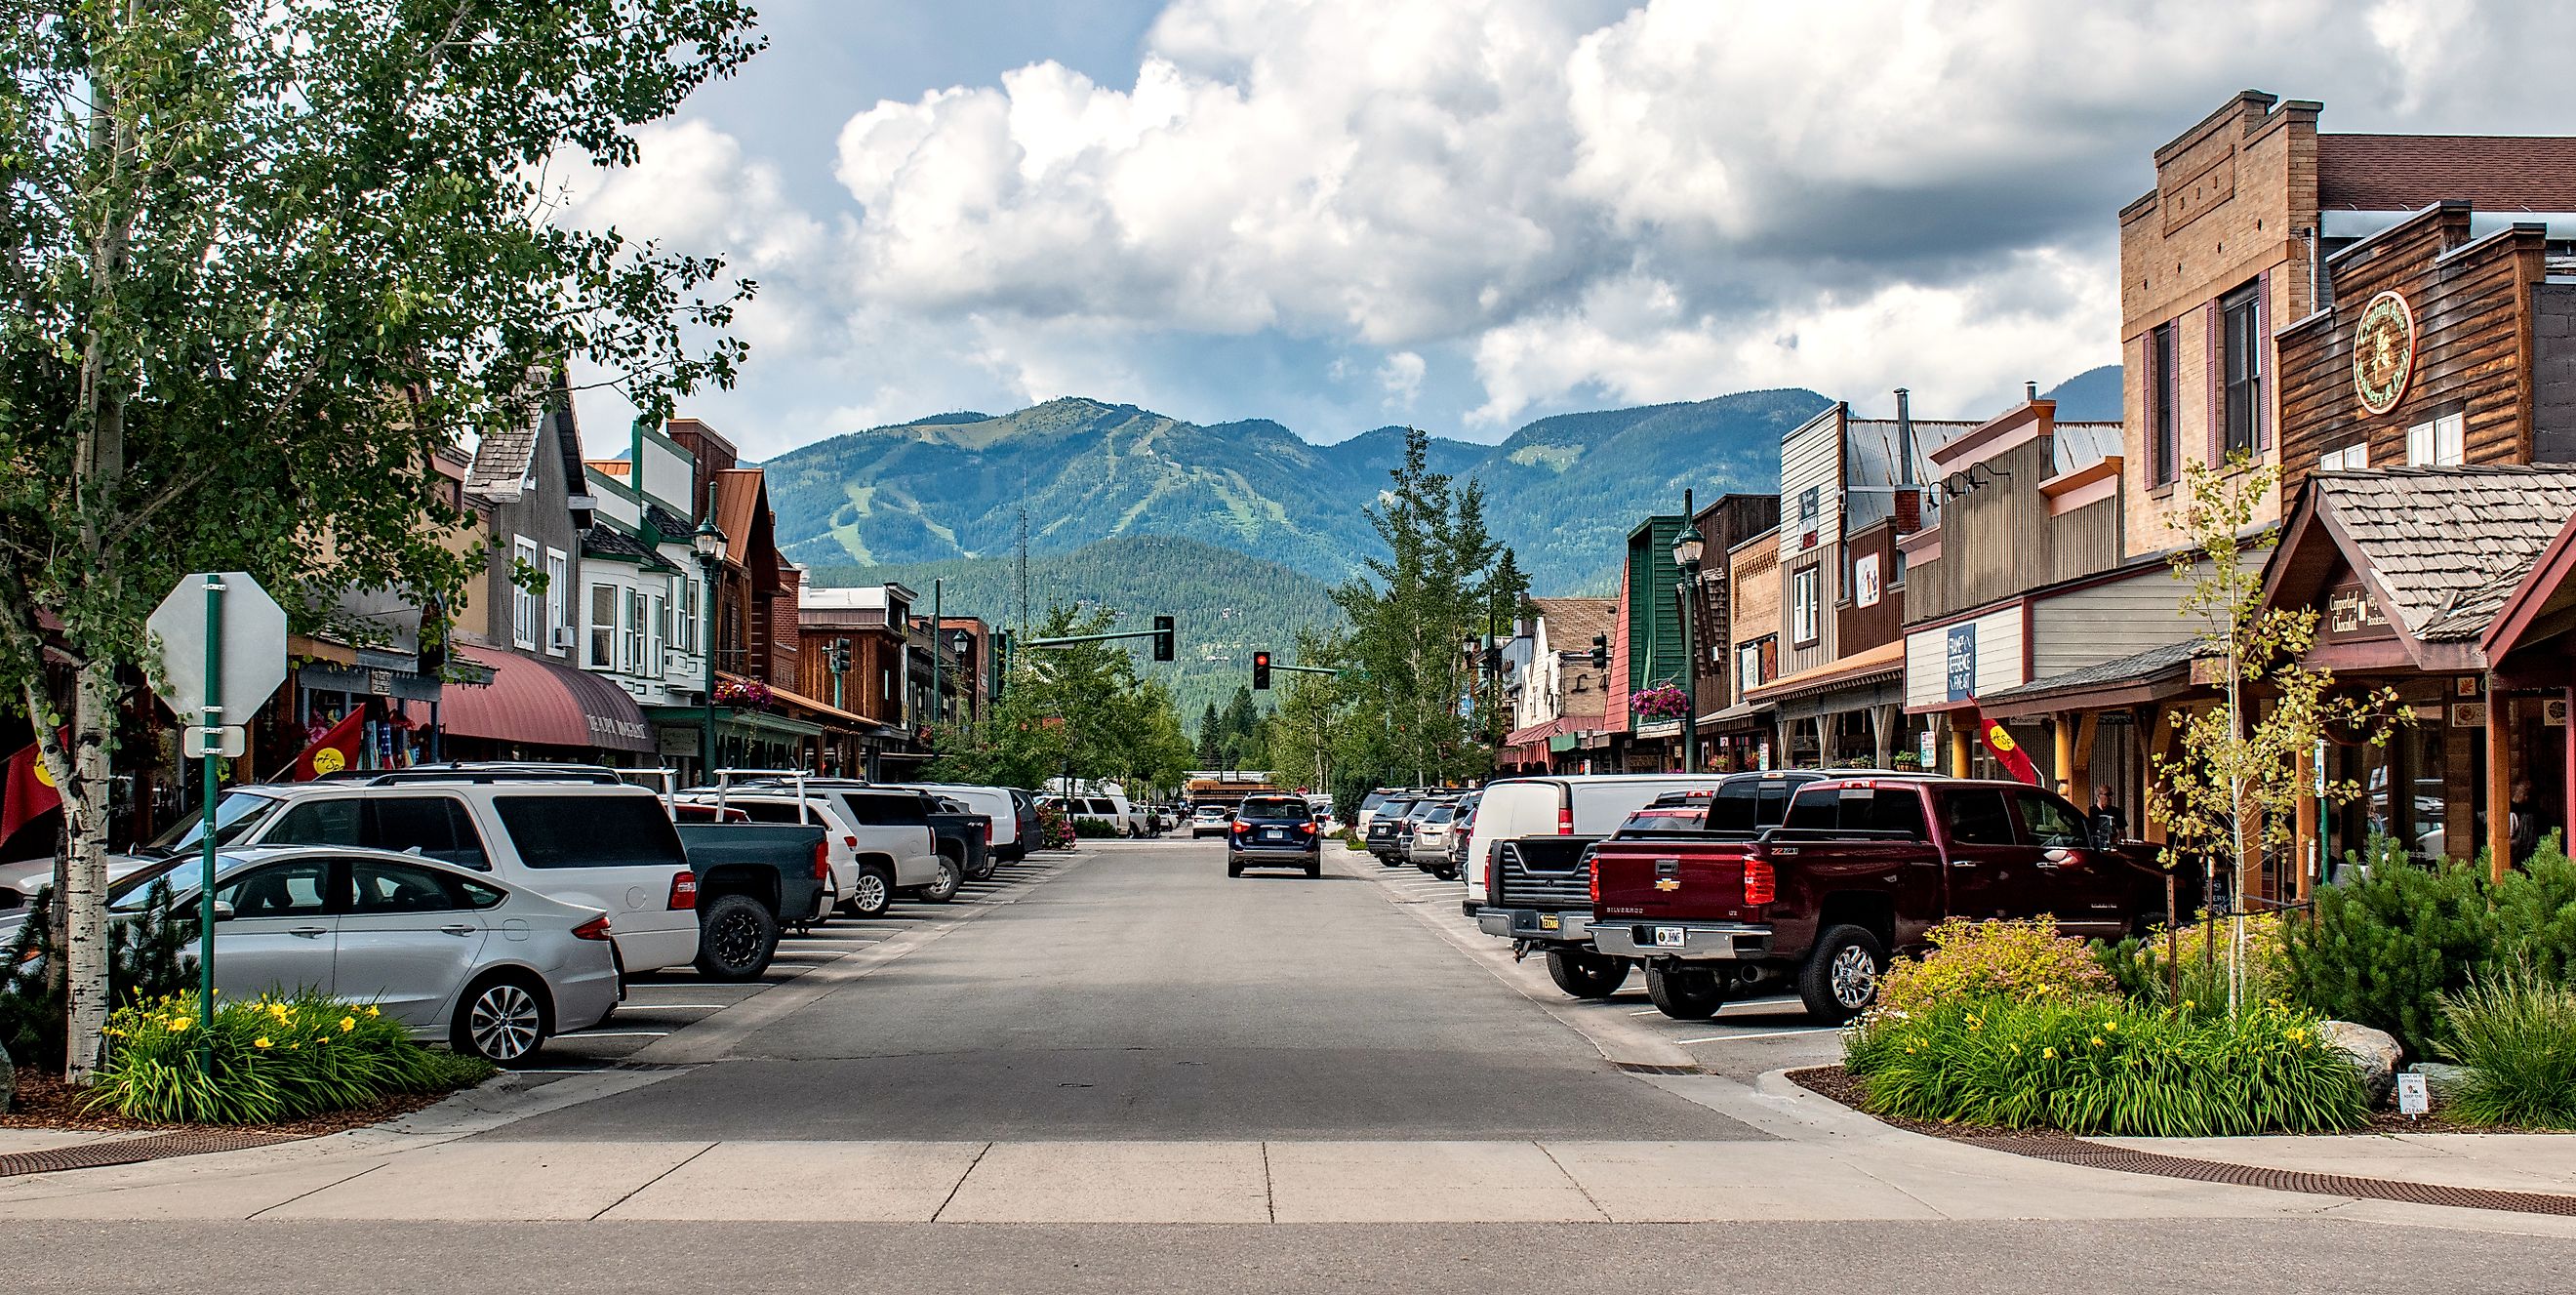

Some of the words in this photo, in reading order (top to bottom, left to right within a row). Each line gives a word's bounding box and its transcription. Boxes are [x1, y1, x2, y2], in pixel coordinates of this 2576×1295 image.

[2359, 299, 2390, 344] Central
[2356, 358, 2384, 408] Bakery
[2392, 346, 2409, 392] Deli
[2329, 589, 2358, 616] Copperleaf
[2331, 613, 2358, 633] Chocolat
